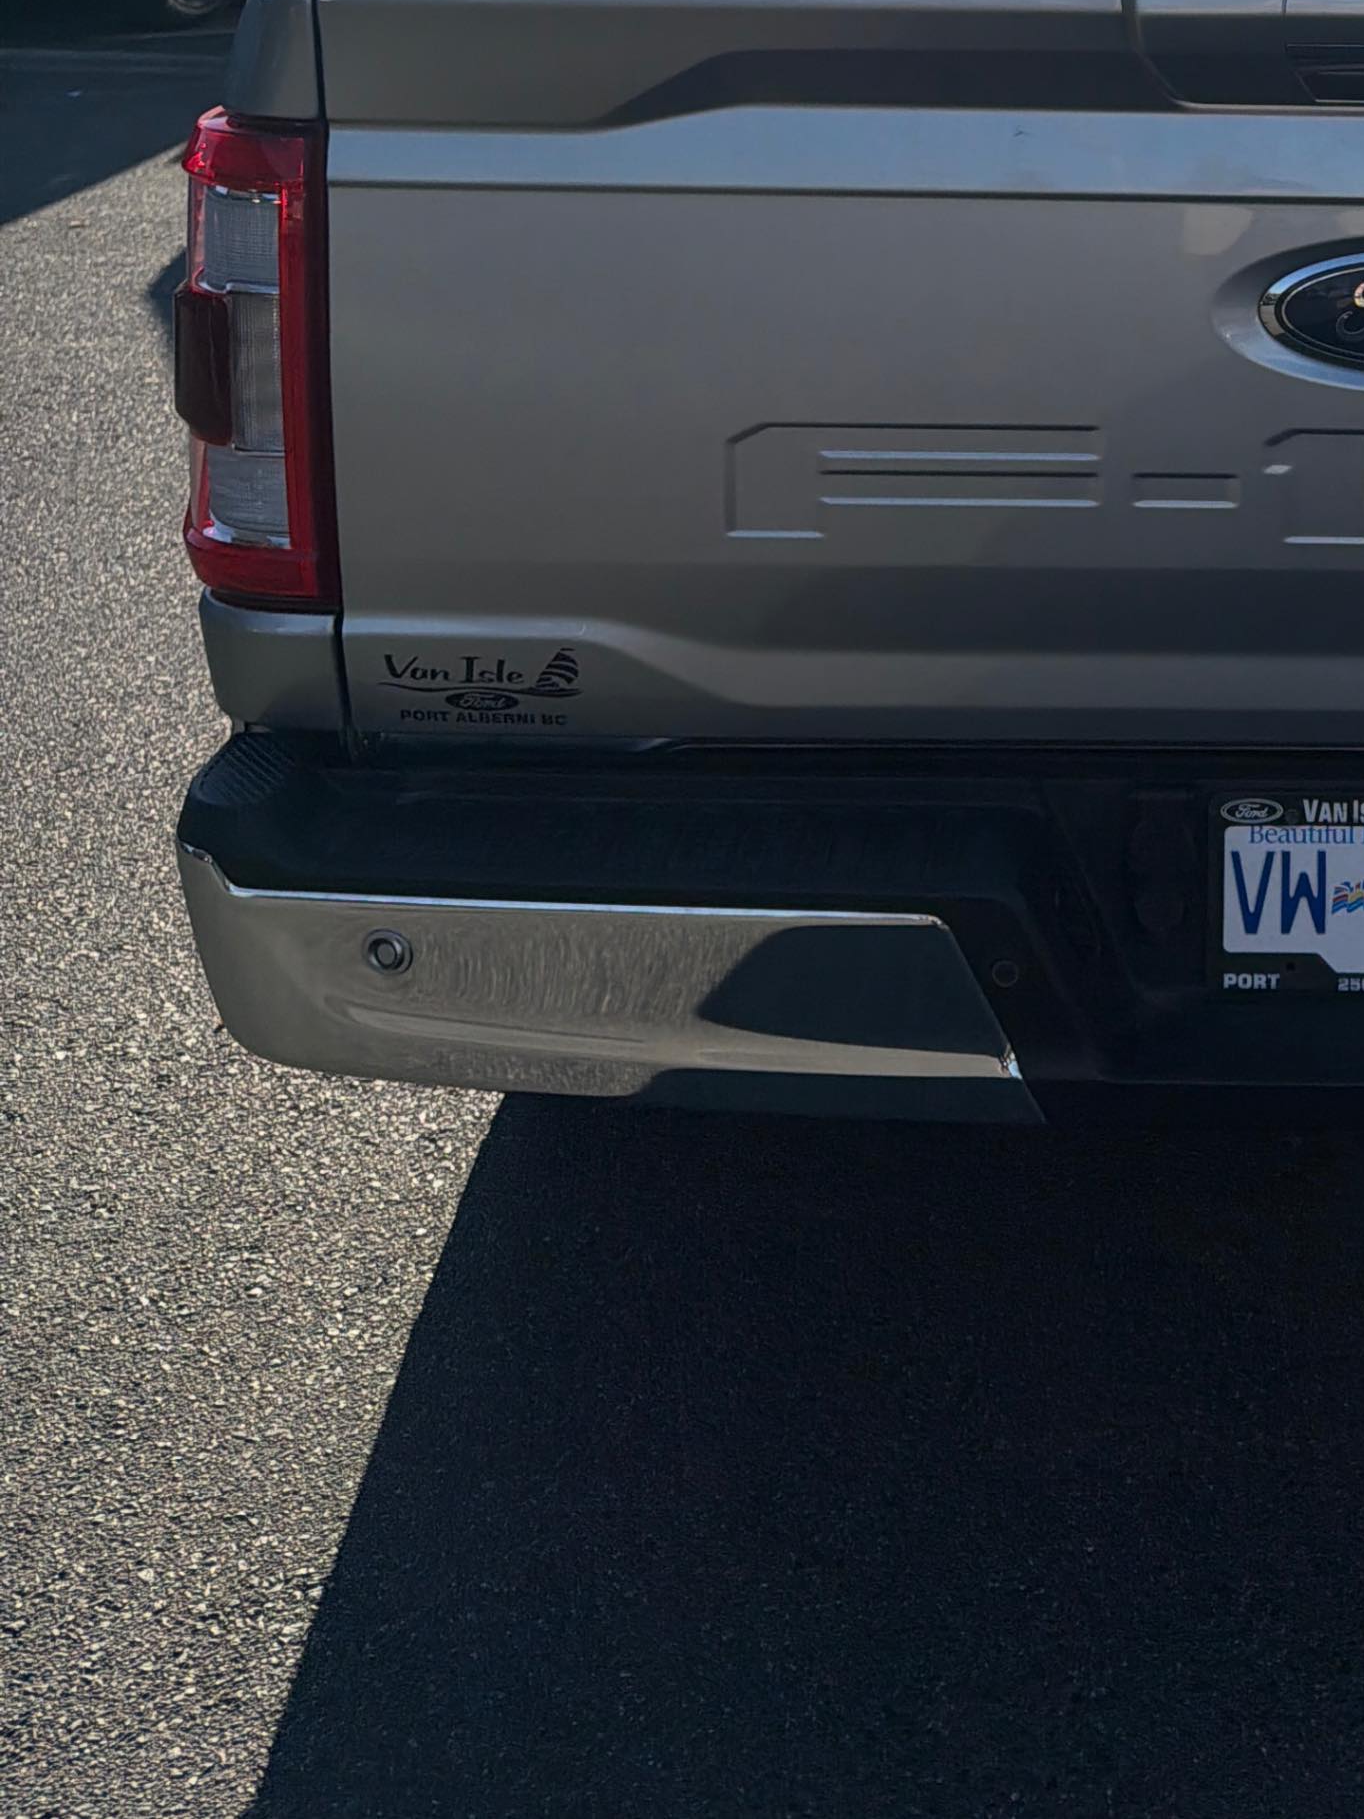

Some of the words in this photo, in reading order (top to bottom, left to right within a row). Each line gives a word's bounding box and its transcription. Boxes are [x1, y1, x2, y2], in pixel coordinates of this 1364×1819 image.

[384, 654, 450, 681] Van
[458, 656, 525, 684] Isle
[400, 710, 450, 722] PORT
[455, 711, 536, 725] ALBERNI
[541, 714, 569, 726] BC
[1234, 804, 1269, 819] Ford
[1303, 799, 1348, 824] VAN
[1249, 826, 1354, 845] Beautiful
[1231, 850, 1327, 935] VW
[1223, 974, 1281, 990] PORT
